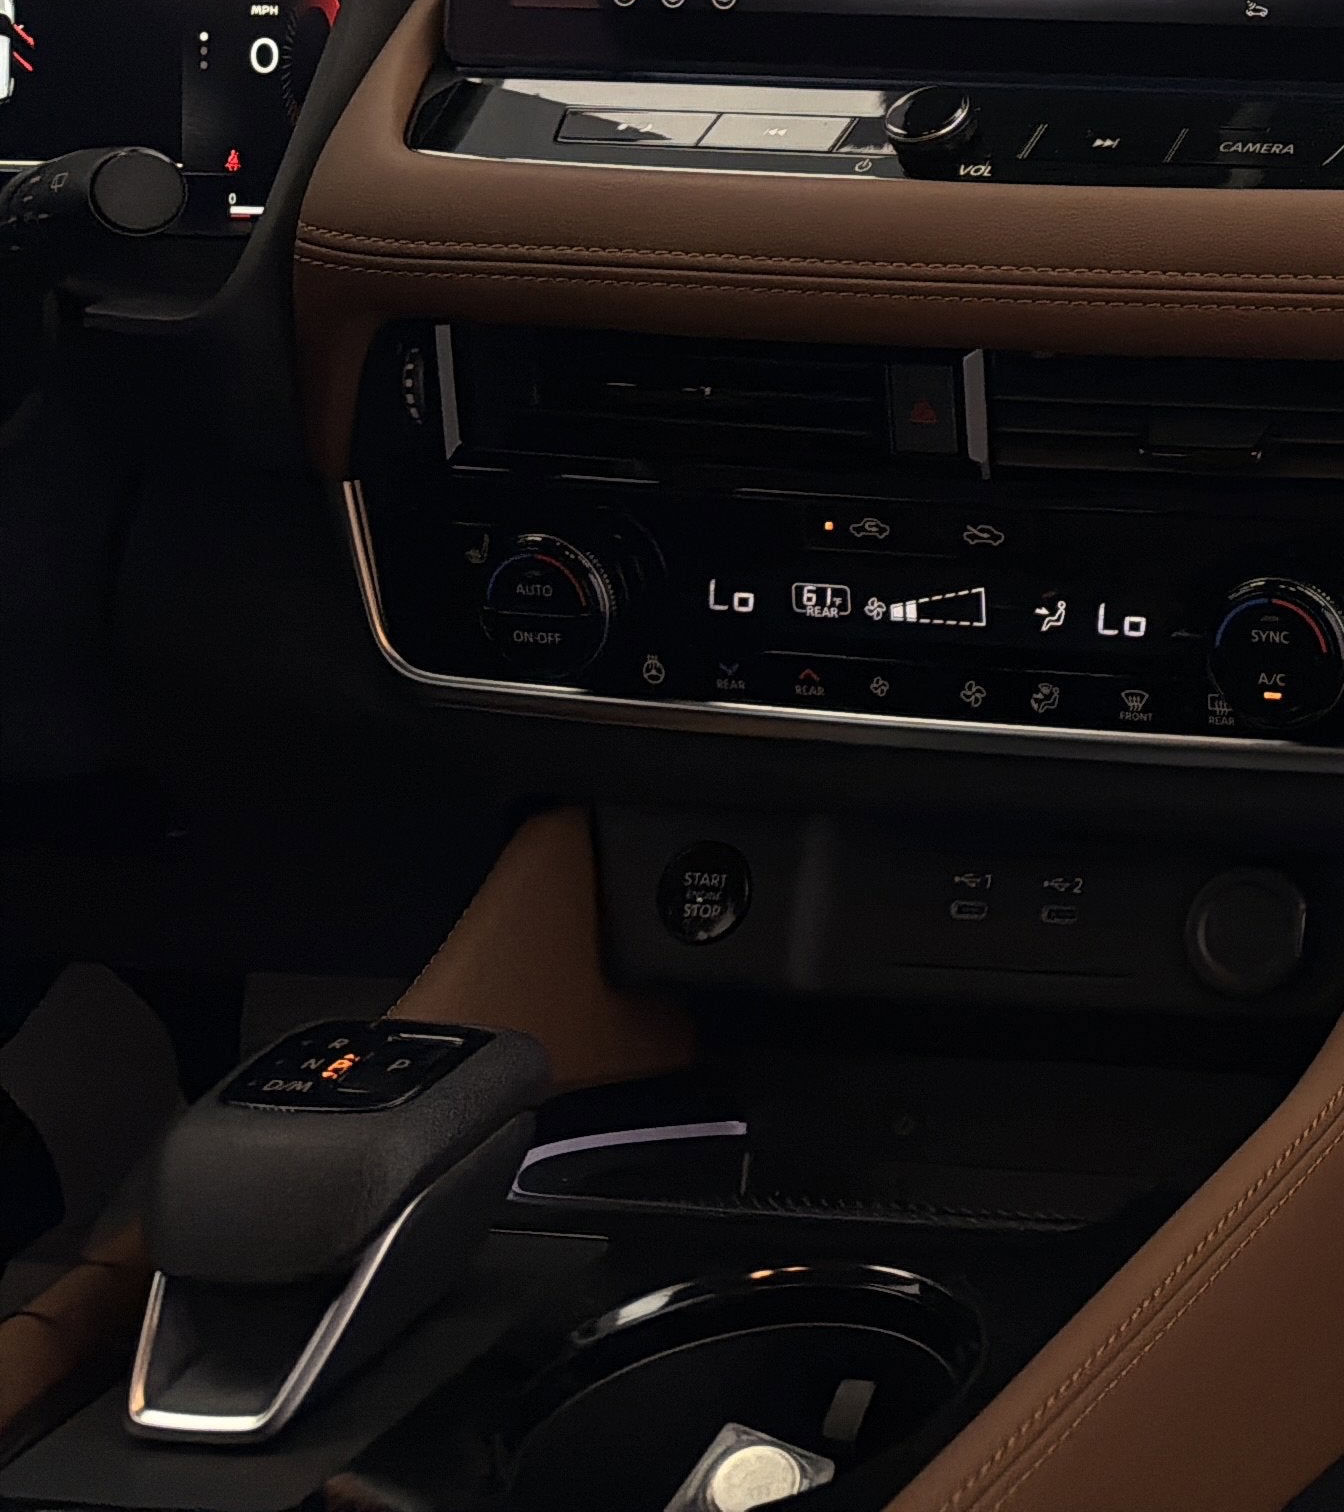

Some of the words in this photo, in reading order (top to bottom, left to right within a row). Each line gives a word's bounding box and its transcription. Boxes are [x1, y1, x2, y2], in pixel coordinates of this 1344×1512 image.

[250, 4, 279, 16] MPH
[250, 37, 279, 75] 0
[1219, 141, 1295, 155] CAMERA
[959, 163, 993, 177] VOL
[228, 193, 237, 206] 0
[516, 583, 553, 597] AUTO
[709, 578, 755, 612] Lo
[806, 605, 839, 618] REAR
[1097, 602, 1147, 637] Lo
[1251, 630, 1290, 645] SYNC
[716, 678, 746, 690] REAR
[1258, 672, 1286, 686] A/C
[795, 684, 825, 696] REAR
[1119, 710, 1152, 722] FRONT
[1208, 715, 1235, 726] REAR
[683, 872, 728, 888] START
[985, 874, 992, 889] 1
[1073, 877, 1083, 893] 2
[683, 903, 722, 919] STOP
[327, 1038, 350, 1049] R
[300, 1058, 326, 1070] N
[386, 1058, 412, 1072] P
[262, 1079, 313, 1092] D/M
